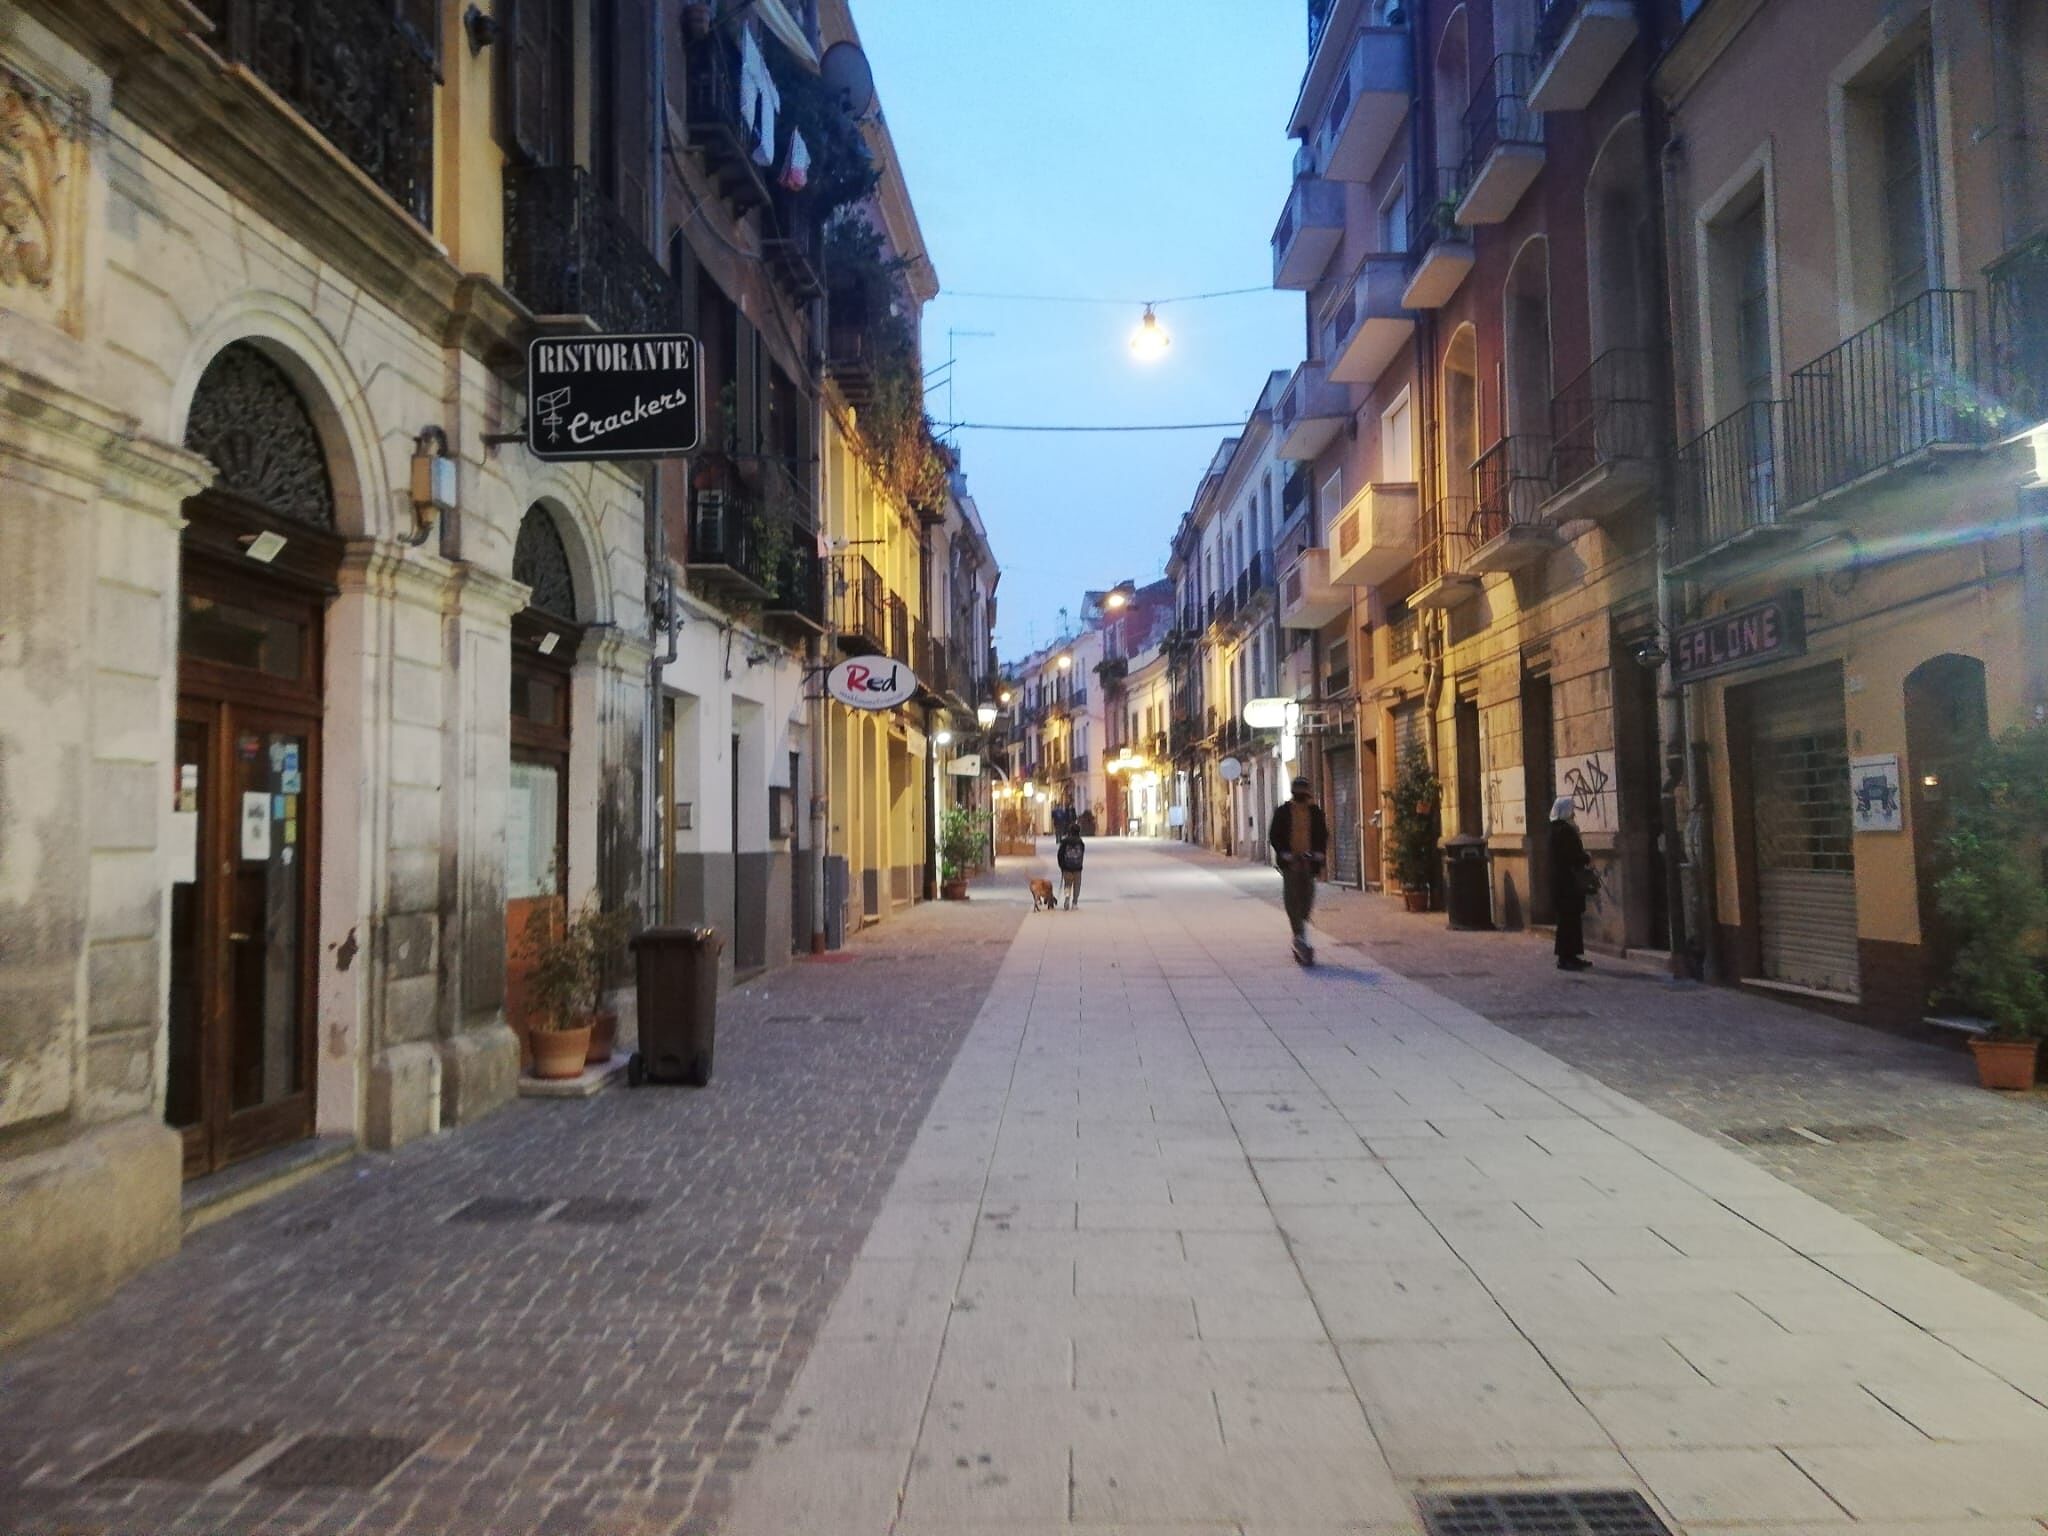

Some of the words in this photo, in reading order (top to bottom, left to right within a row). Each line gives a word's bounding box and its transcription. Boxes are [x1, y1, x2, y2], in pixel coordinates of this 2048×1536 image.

[538, 341, 689, 373] RISTORANTE
[567, 388, 687, 444] Crackers
[1679, 608, 1777, 671] SALONE
[846, 664, 898, 692] Red
